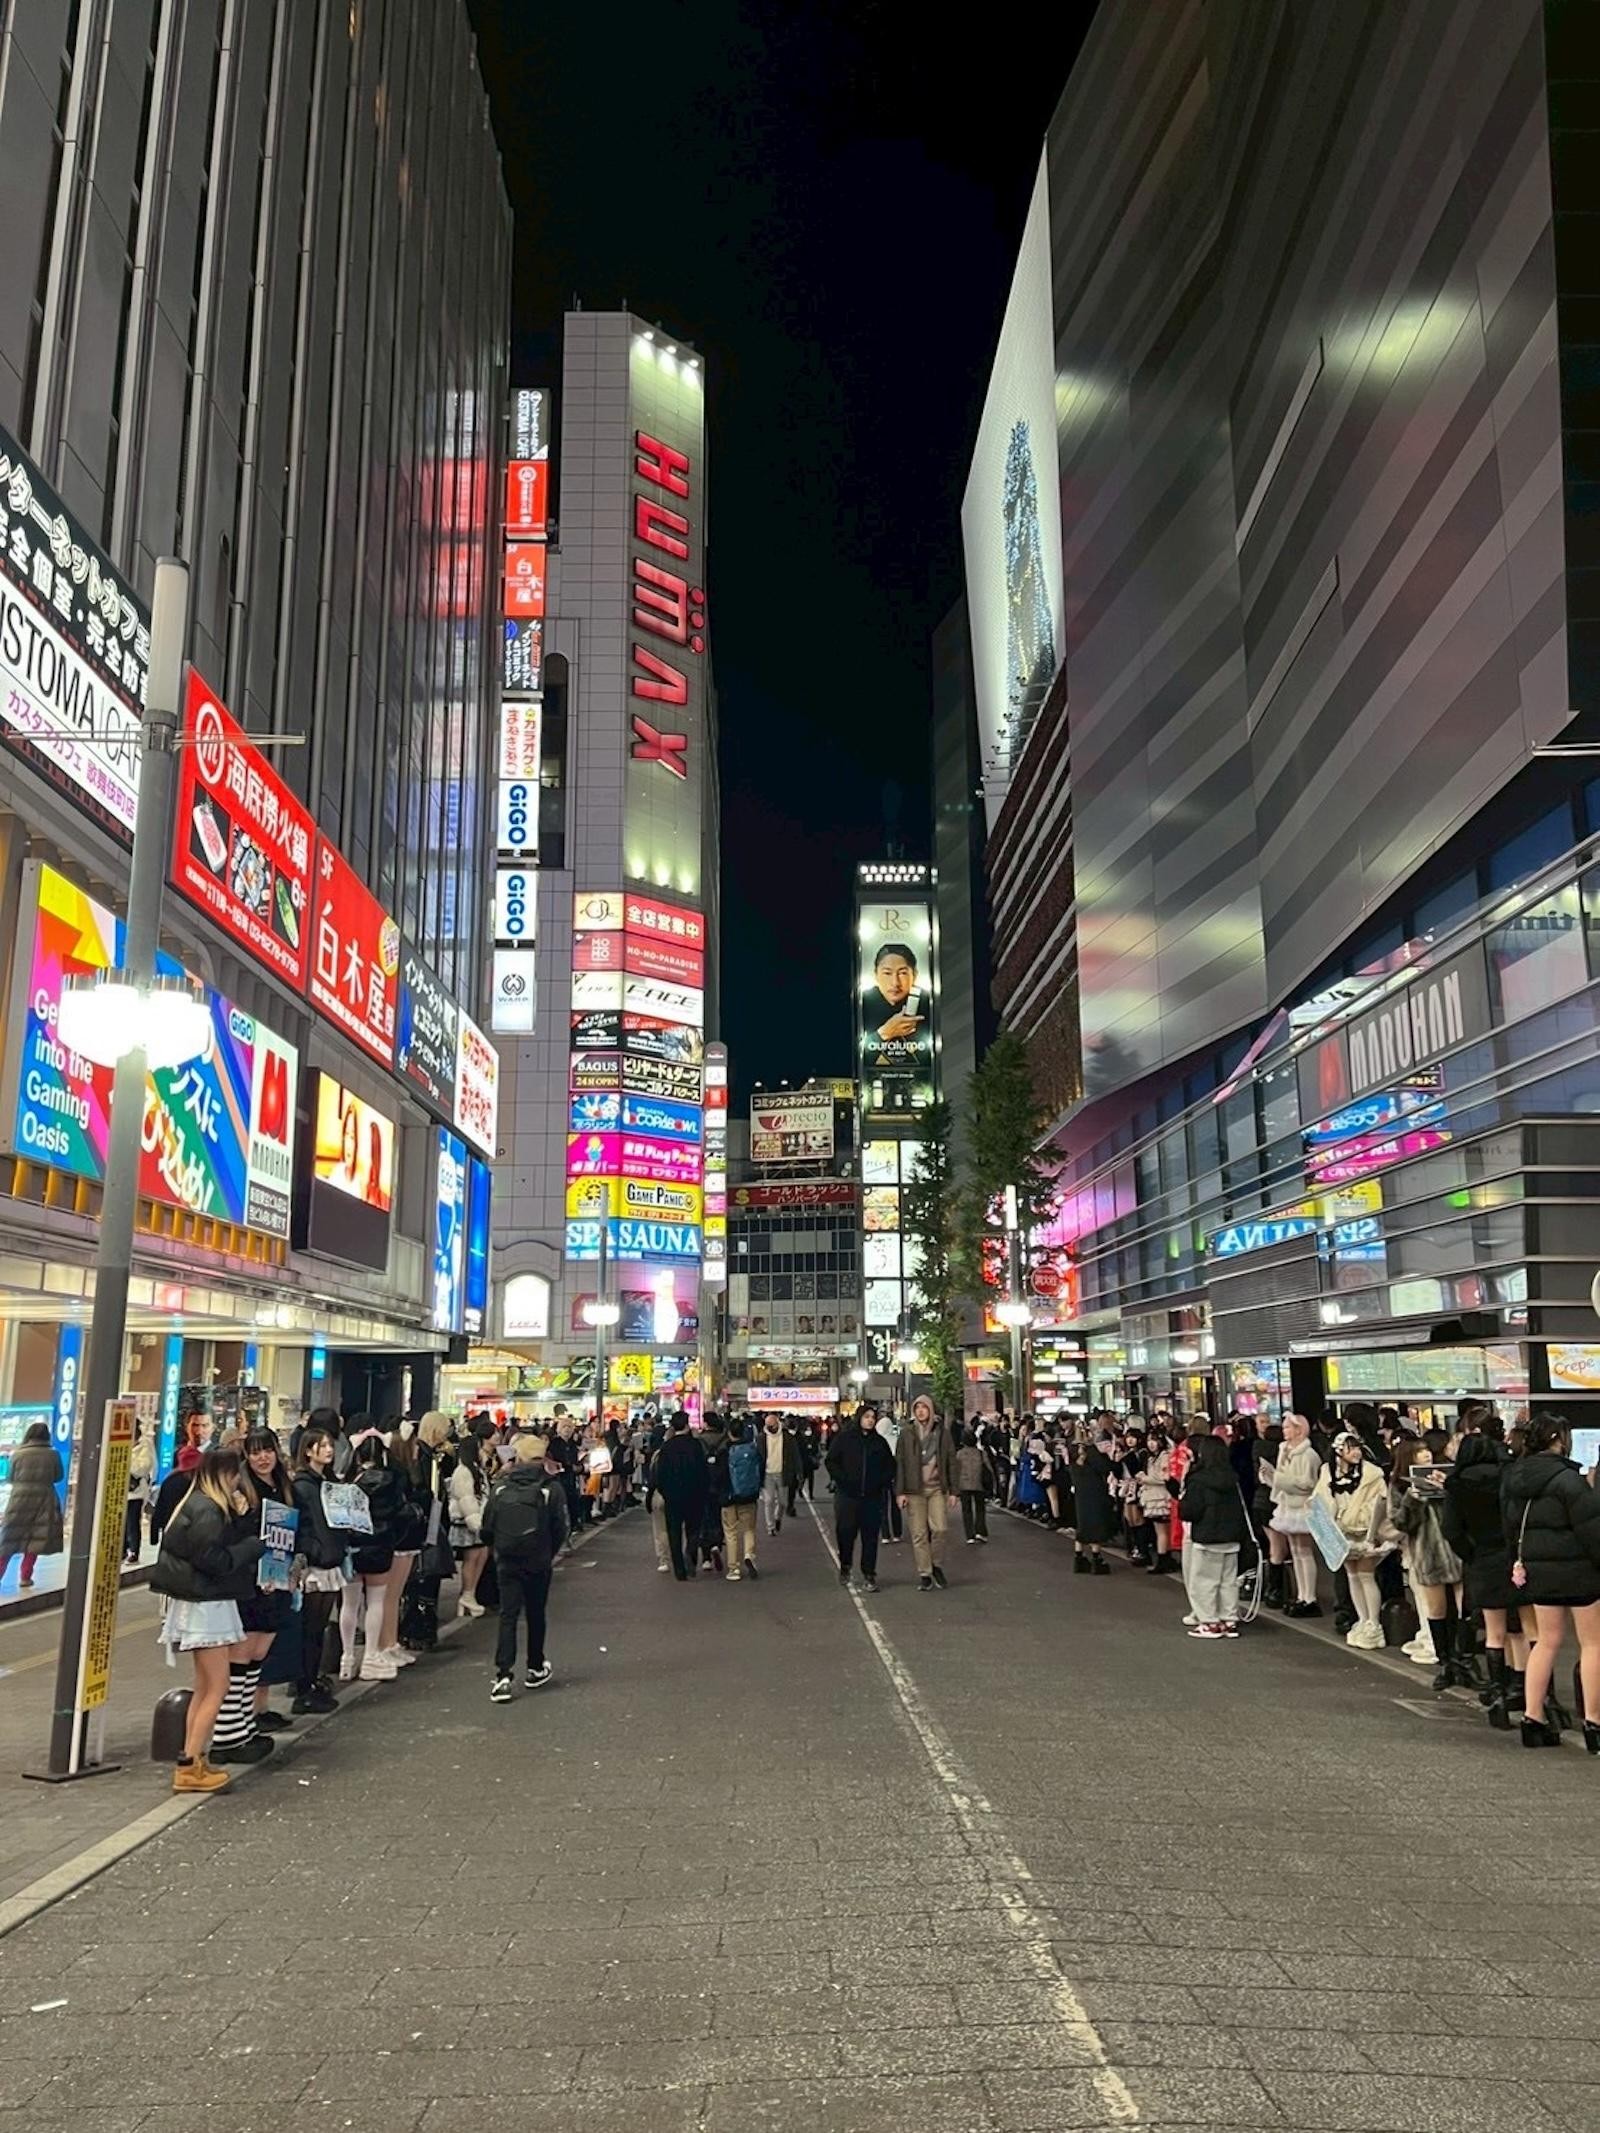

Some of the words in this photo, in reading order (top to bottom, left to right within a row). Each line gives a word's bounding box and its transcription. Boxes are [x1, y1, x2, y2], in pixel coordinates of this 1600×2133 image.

[0, 454, 150, 666] ターネットカフェ
[631, 429, 705, 781] HUMAX
[524, 719, 536, 766] カラオケ
[508, 784, 528, 845] GiGO
[291, 876, 307, 911] 6F
[506, 874, 526, 935] GiGO
[626, 904, 700, 939] 全店営業中
[316, 899, 386, 1035] 白木屋
[34, 988, 59, 1026] Ge
[231, 1011, 254, 1041] GiGO
[1349, 970, 1465, 1094] MARUHAN
[35, 1030, 67, 1072] into
[69, 1051, 94, 1085] the
[26, 1070, 91, 1130] Gaming
[22, 1110, 70, 1156] Oasis
[619, 1222, 700, 1253] SAUNA
[1554, 1358, 1595, 1376] Crepe
